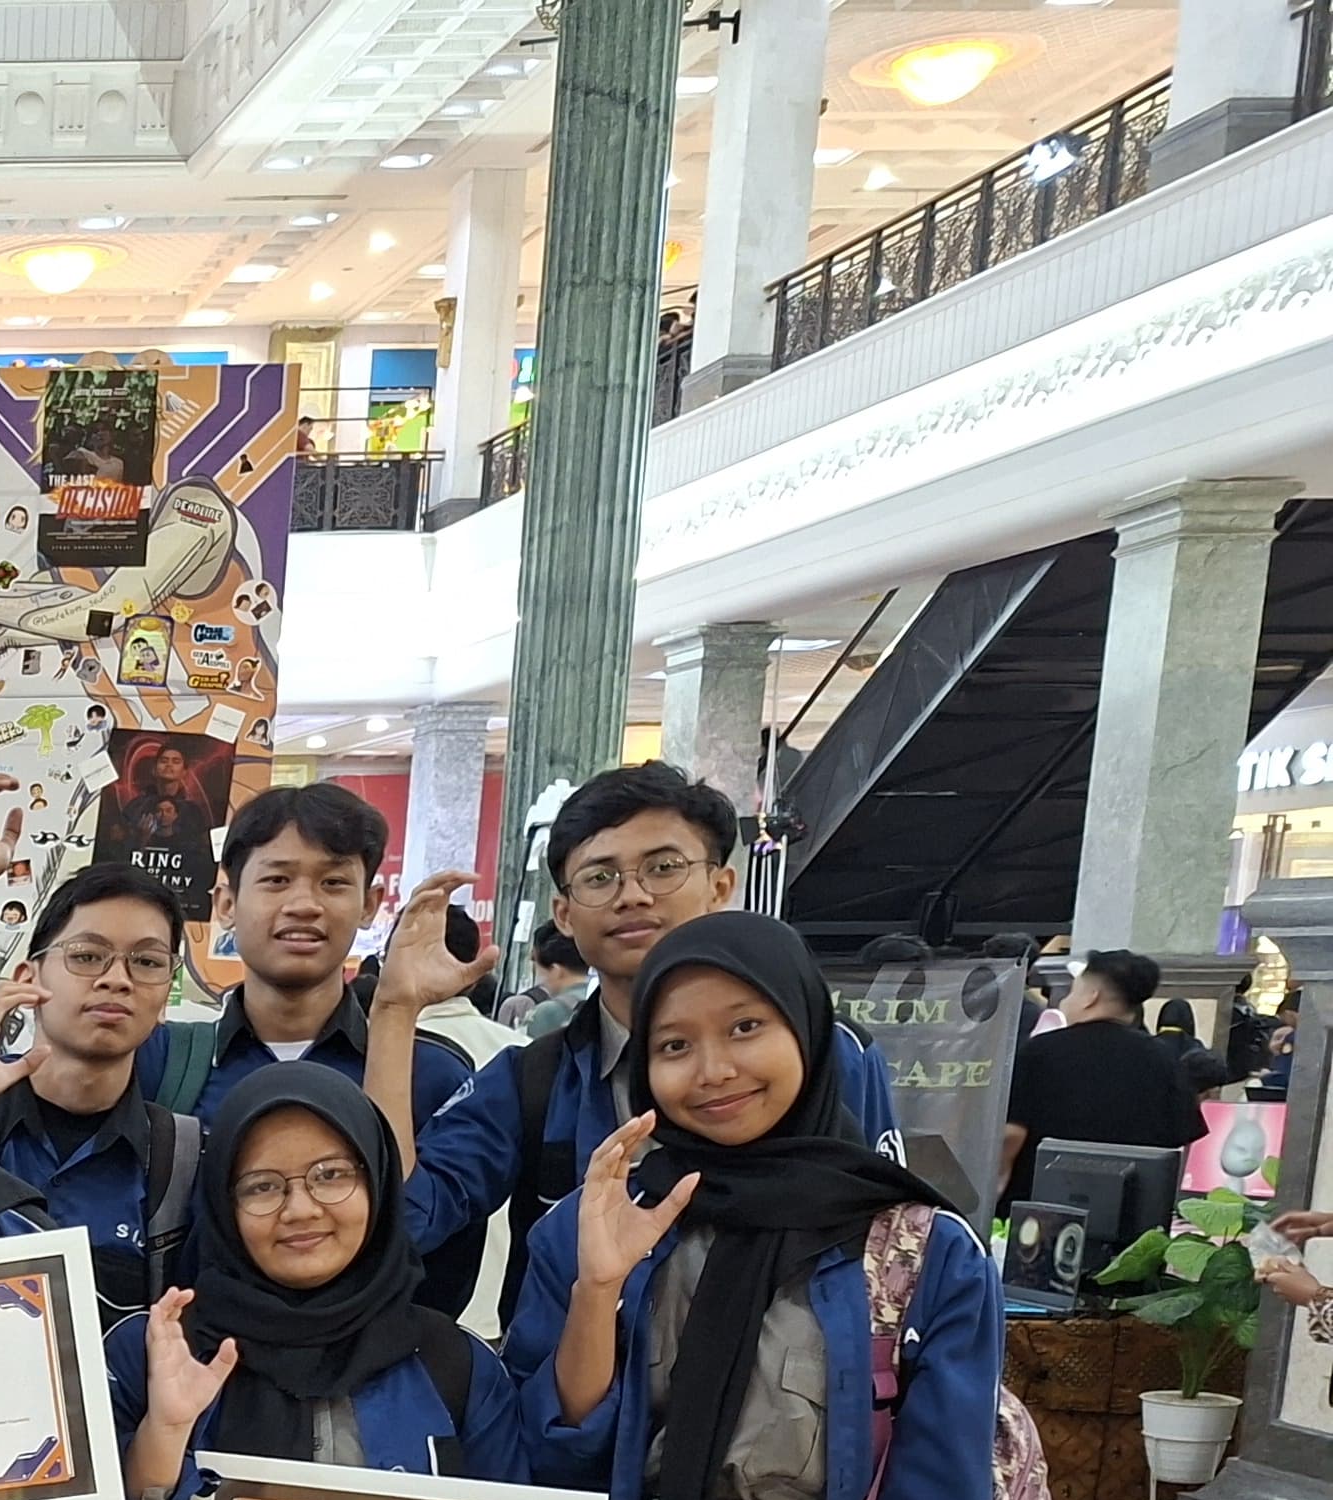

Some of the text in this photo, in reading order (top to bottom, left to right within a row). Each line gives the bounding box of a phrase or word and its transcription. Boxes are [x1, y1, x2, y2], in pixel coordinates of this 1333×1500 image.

[49, 474, 95, 487] THE LAST
[57, 486, 144, 519] DECISION
[174, 499, 223, 521] DEADLINE
[131, 851, 182, 870] RING
[833, 990, 950, 1025] RIM
